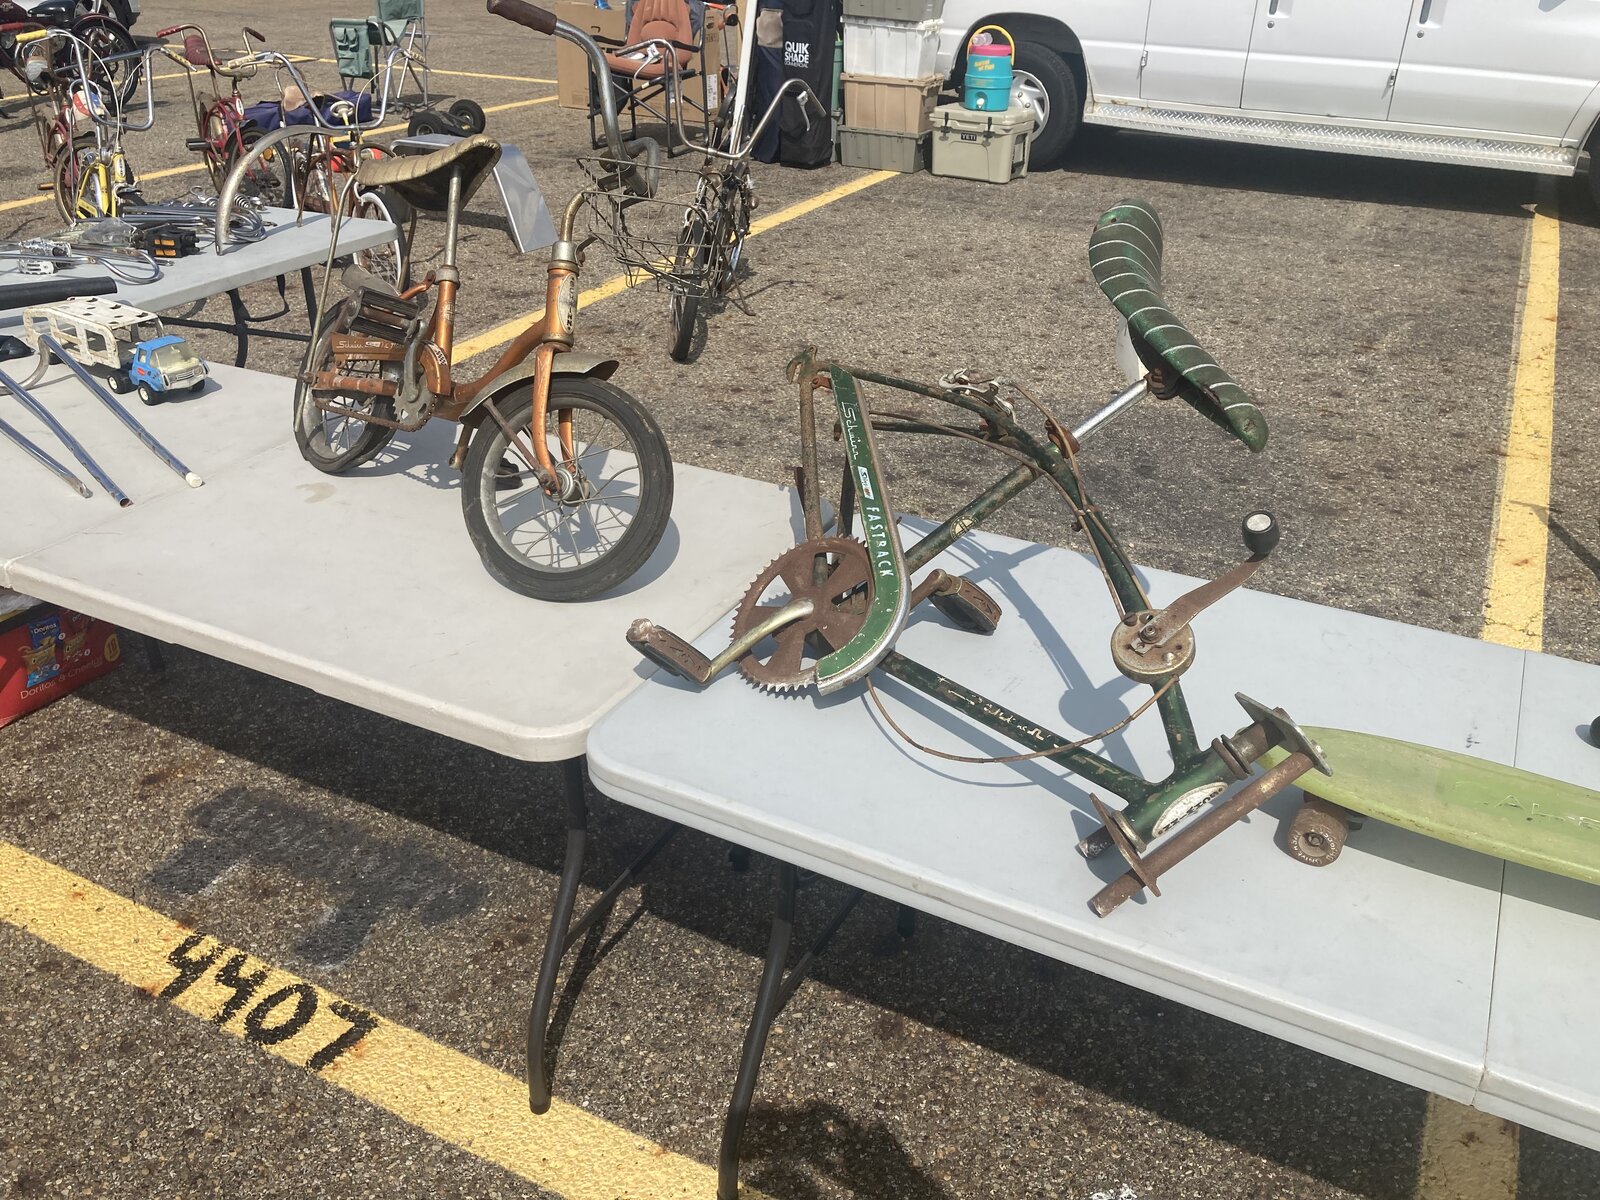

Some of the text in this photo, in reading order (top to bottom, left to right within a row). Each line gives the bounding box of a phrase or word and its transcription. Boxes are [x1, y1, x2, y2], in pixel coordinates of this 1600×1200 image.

[784, 41, 809, 55] QUIK
[784, 52, 809, 64] SHADE
[841, 401, 861, 460] Schwinn
[866, 507, 894, 576] FASTRACK
[20, 680, 57, 699] Doritos
[158, 931, 379, 1074] 4407
